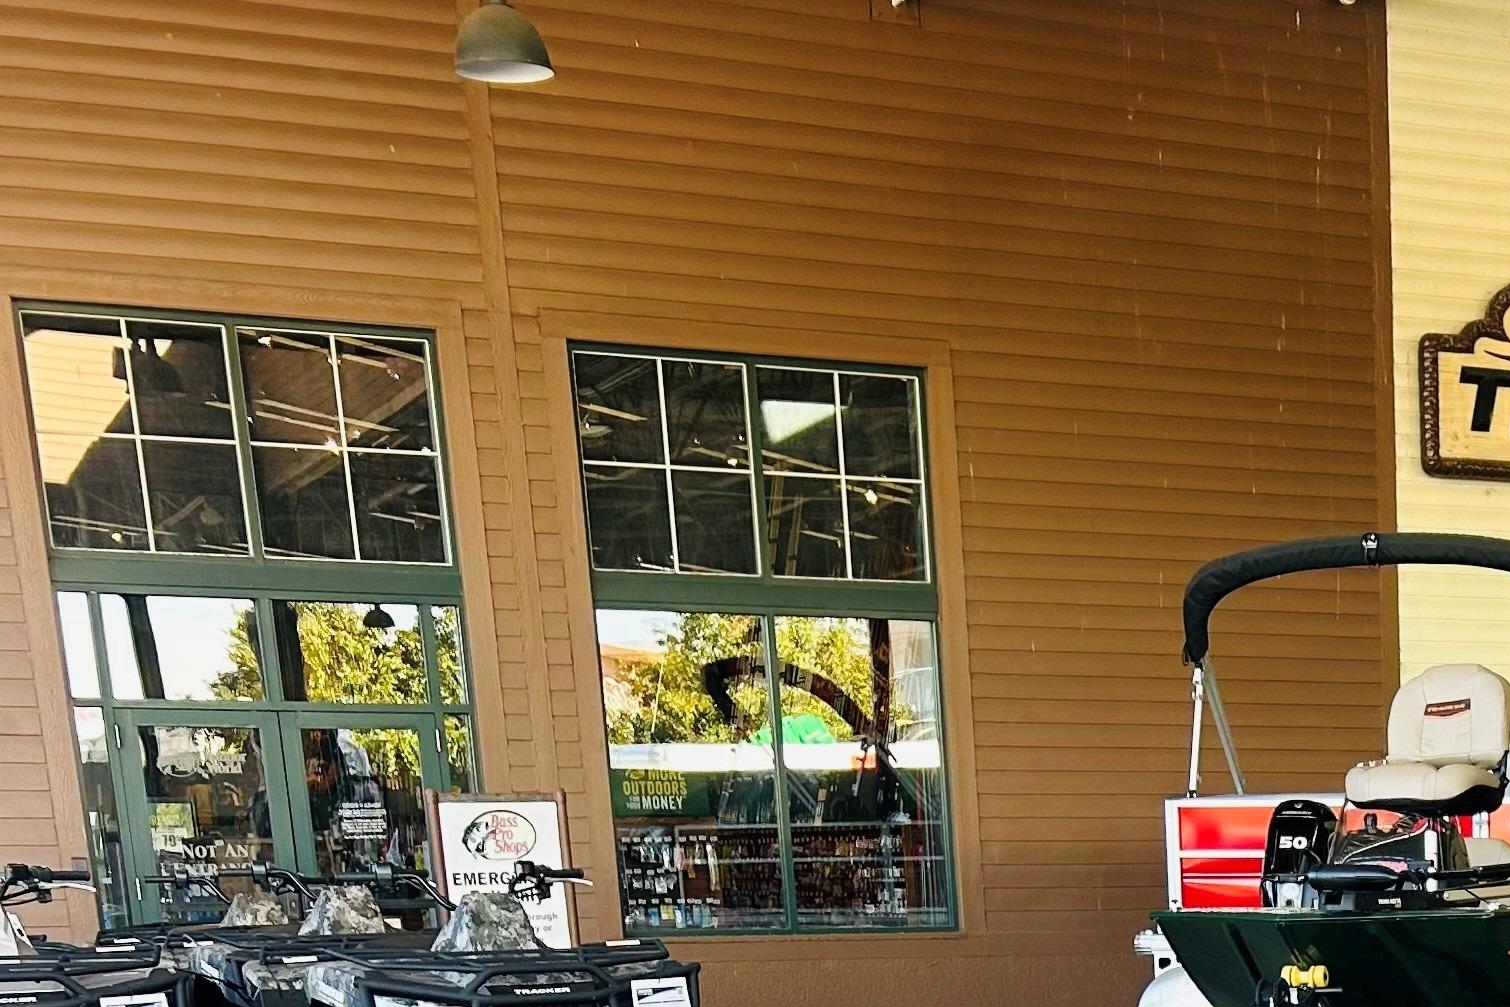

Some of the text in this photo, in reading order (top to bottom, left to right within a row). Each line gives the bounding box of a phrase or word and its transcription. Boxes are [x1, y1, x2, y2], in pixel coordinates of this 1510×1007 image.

[623, 780, 687, 796] OUTDOORS
[642, 795, 683, 810] MONEY
[490, 814, 519, 828] Bass
[494, 827, 513, 840] Pro
[495, 840, 529, 856] Shops
[1278, 835, 1308, 850] 50
[182, 843, 249, 859] NOT AN
[453, 872, 512, 887] EMERG
[513, 986, 570, 996] TRACKER
